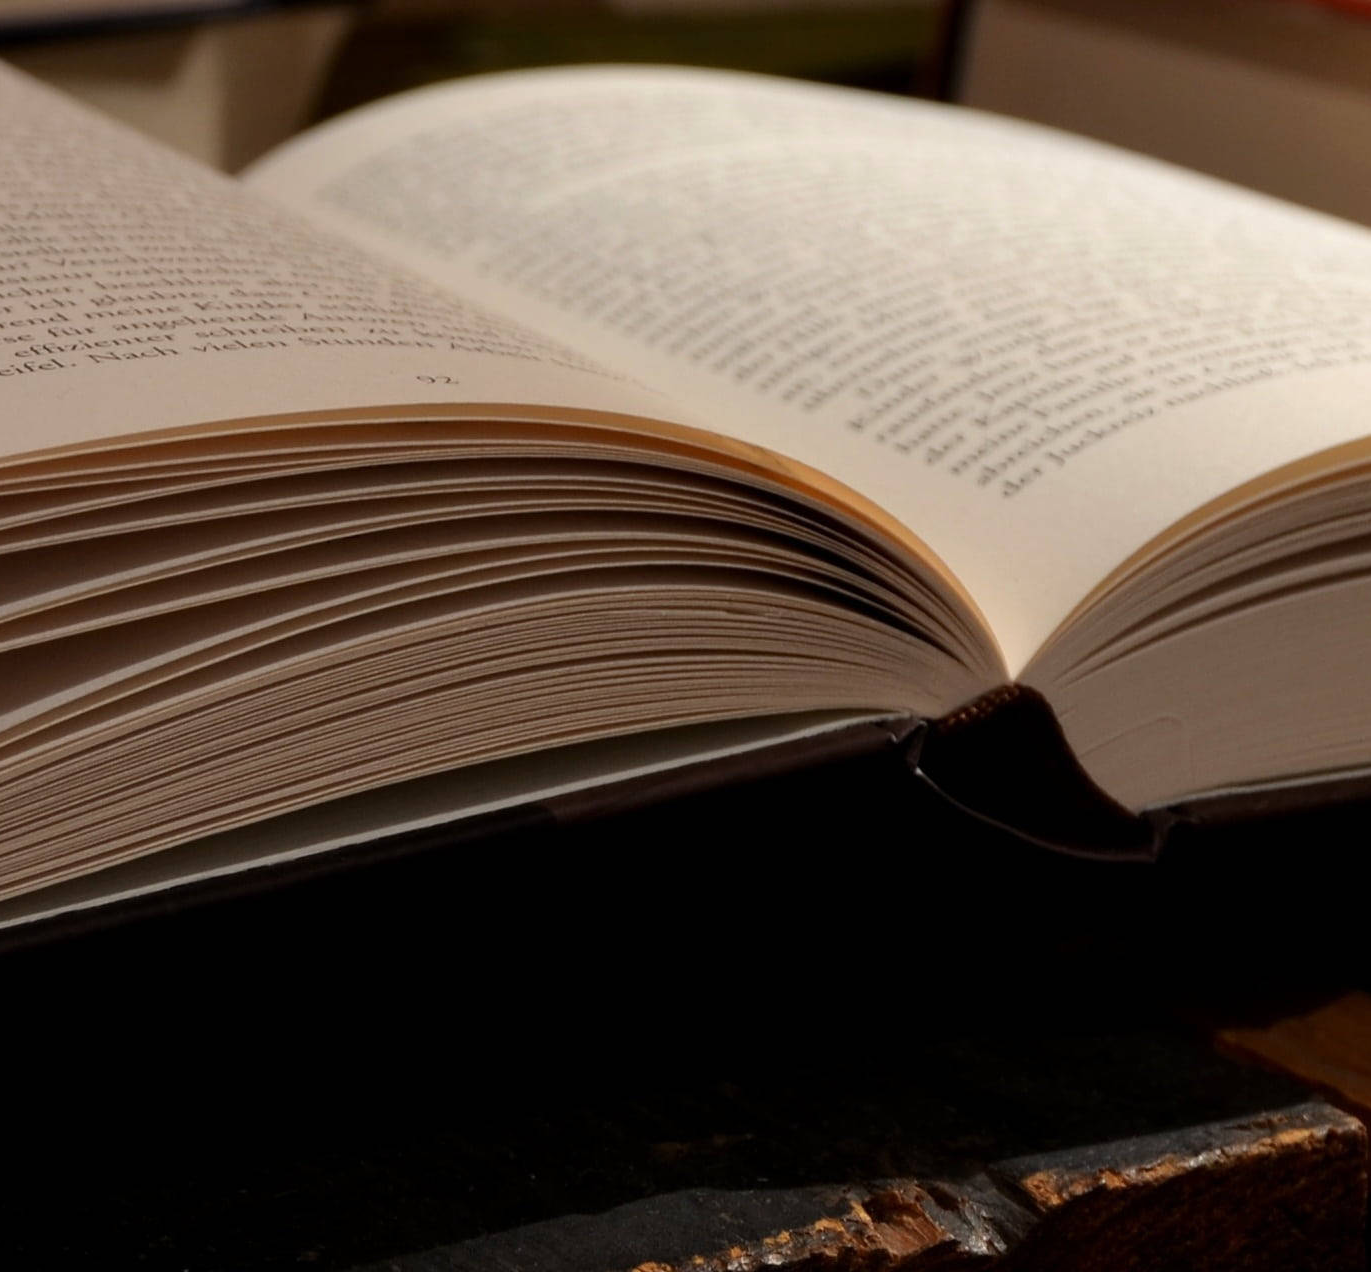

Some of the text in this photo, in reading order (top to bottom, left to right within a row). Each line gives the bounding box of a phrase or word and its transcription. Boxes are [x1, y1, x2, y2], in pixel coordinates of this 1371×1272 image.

[25, 298, 77, 311] ich
[84, 306, 180, 320] meine
[47, 327, 94, 338] für
[112, 312, 282, 332] angehende
[14, 334, 174, 358] effizienter
[194, 324, 346, 339] schreiben
[87, 346, 179, 364] Nach
[192, 339, 288, 353] vielen
[297, 336, 435, 349] Stunden
[416, 375, 460, 385] 92
